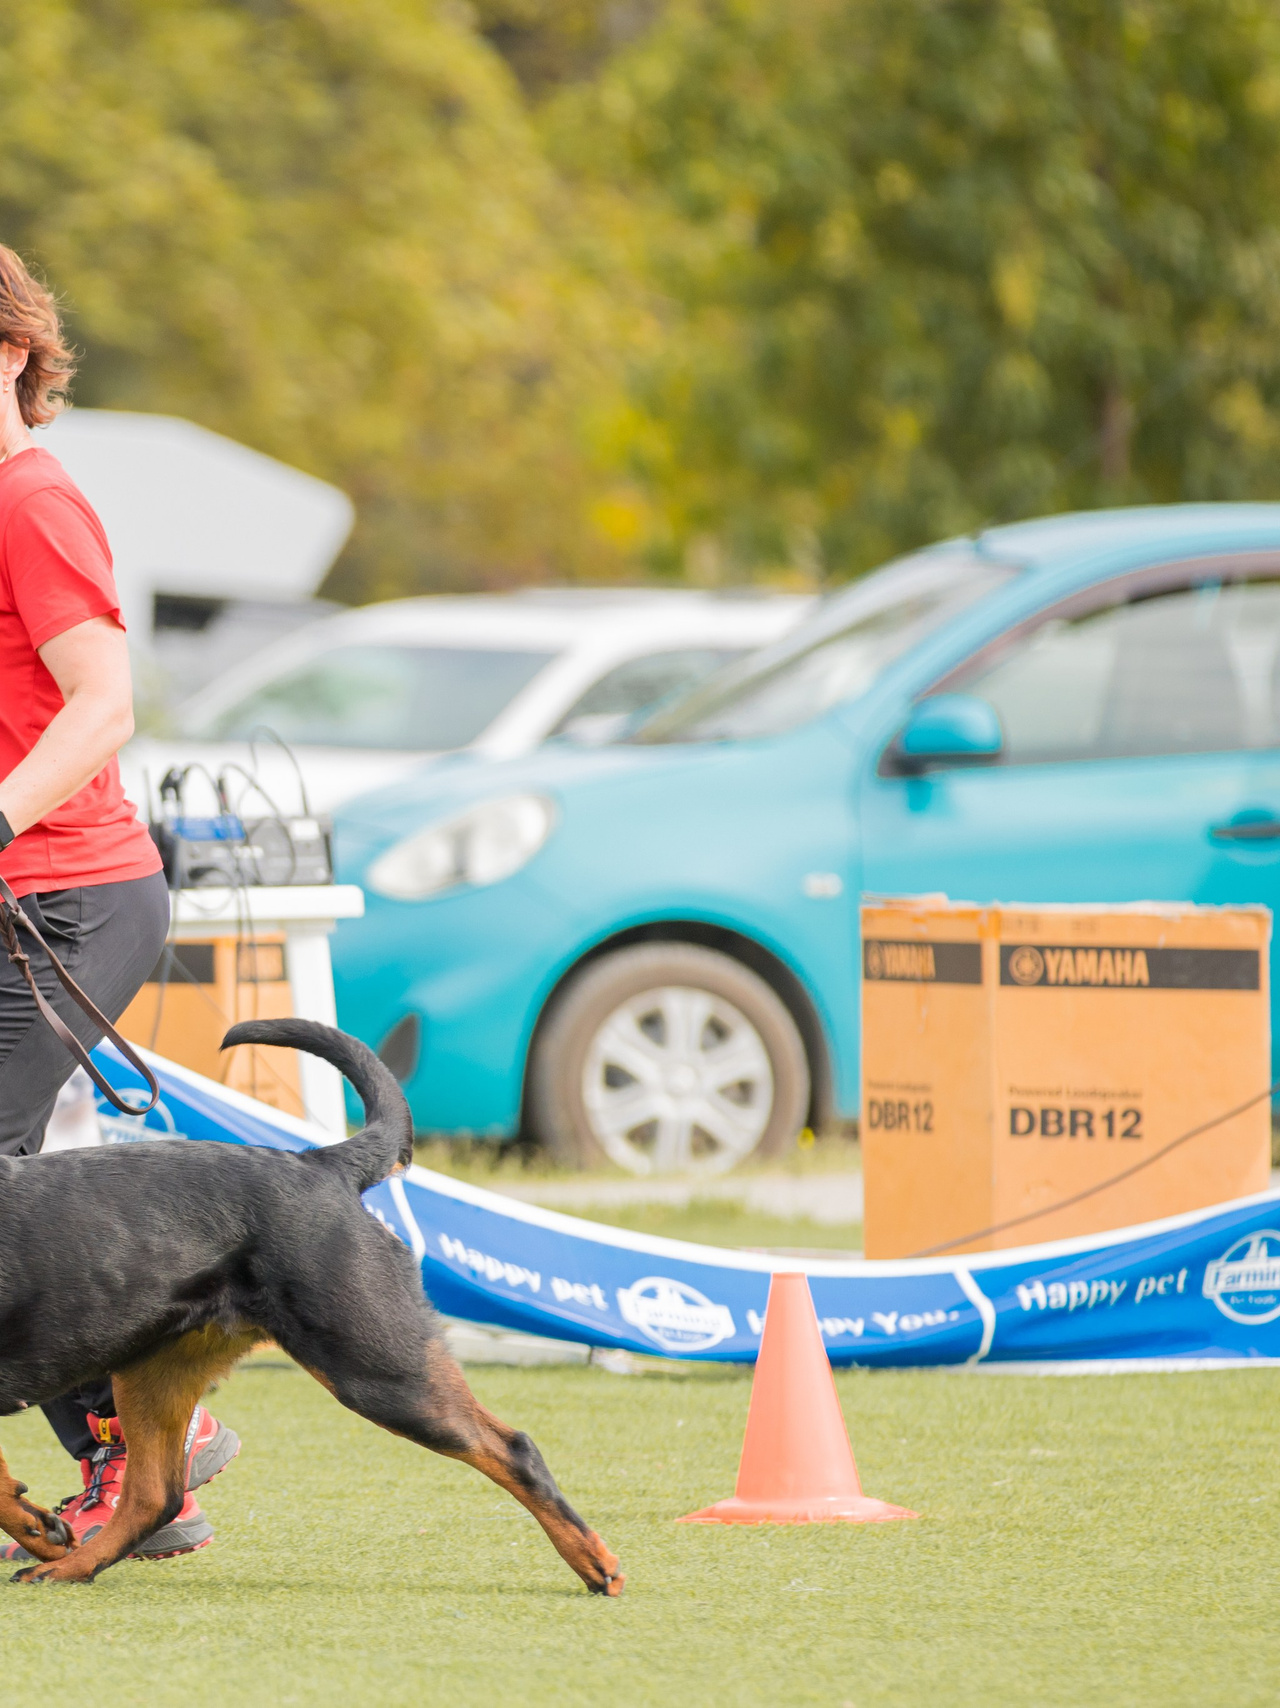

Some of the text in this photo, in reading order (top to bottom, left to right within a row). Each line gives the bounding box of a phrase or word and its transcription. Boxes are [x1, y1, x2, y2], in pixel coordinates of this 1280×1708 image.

[1044, 947, 1151, 986] YAMAHA
[868, 1099, 935, 1133] DBR12
[1009, 1107, 1143, 1139] DBR12
[438, 1232, 609, 1311] Happy pet
[1016, 1267, 1188, 1312] Happy pet
